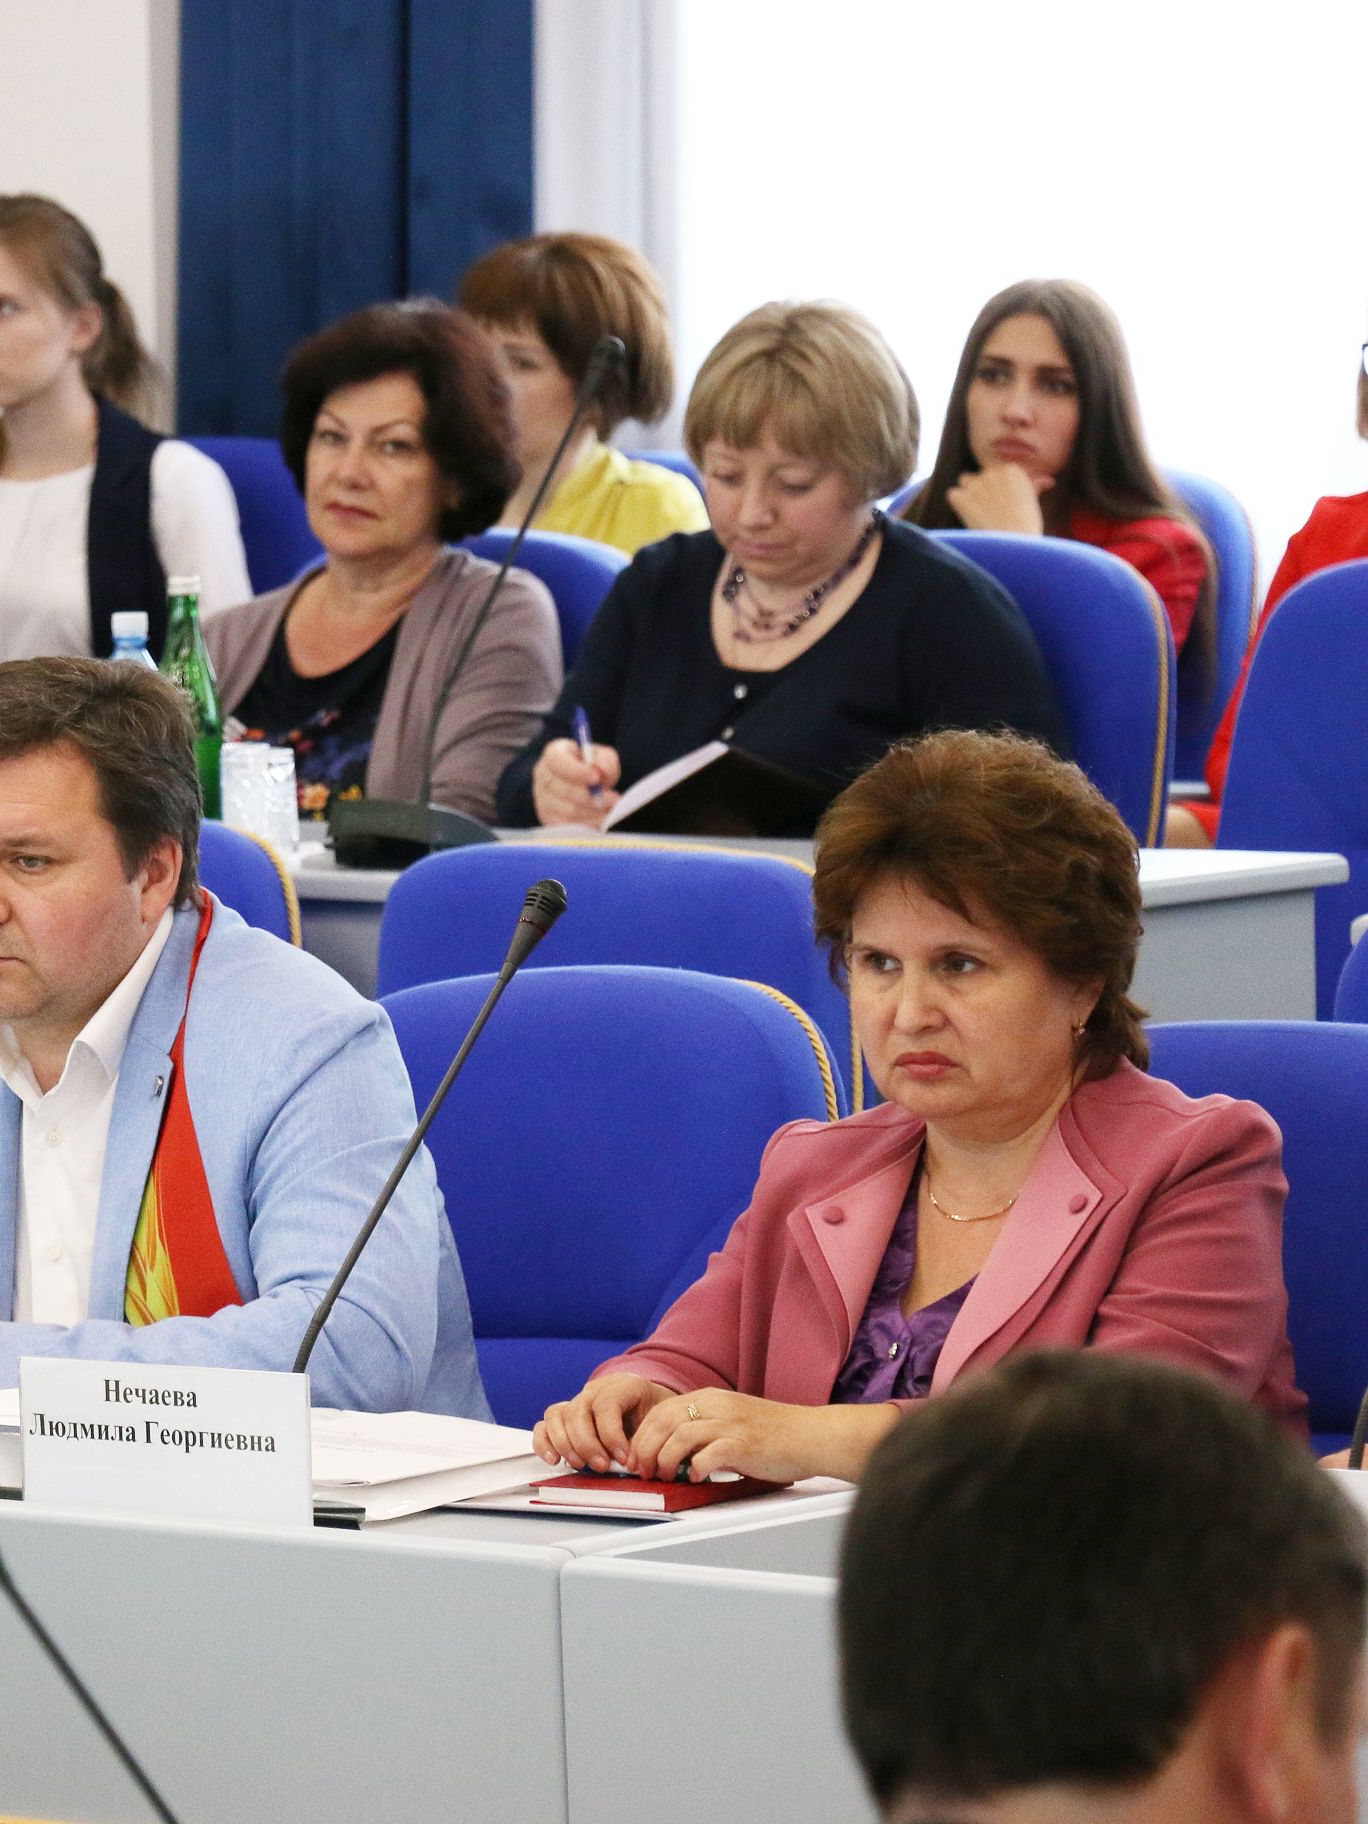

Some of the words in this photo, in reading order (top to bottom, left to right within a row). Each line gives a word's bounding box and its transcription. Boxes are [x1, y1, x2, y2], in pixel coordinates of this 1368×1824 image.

[104, 1379, 198, 1408] Нечаева
[29, 1413, 137, 1444] Людмила
[144, 1421, 277, 1454] Георгиевна
